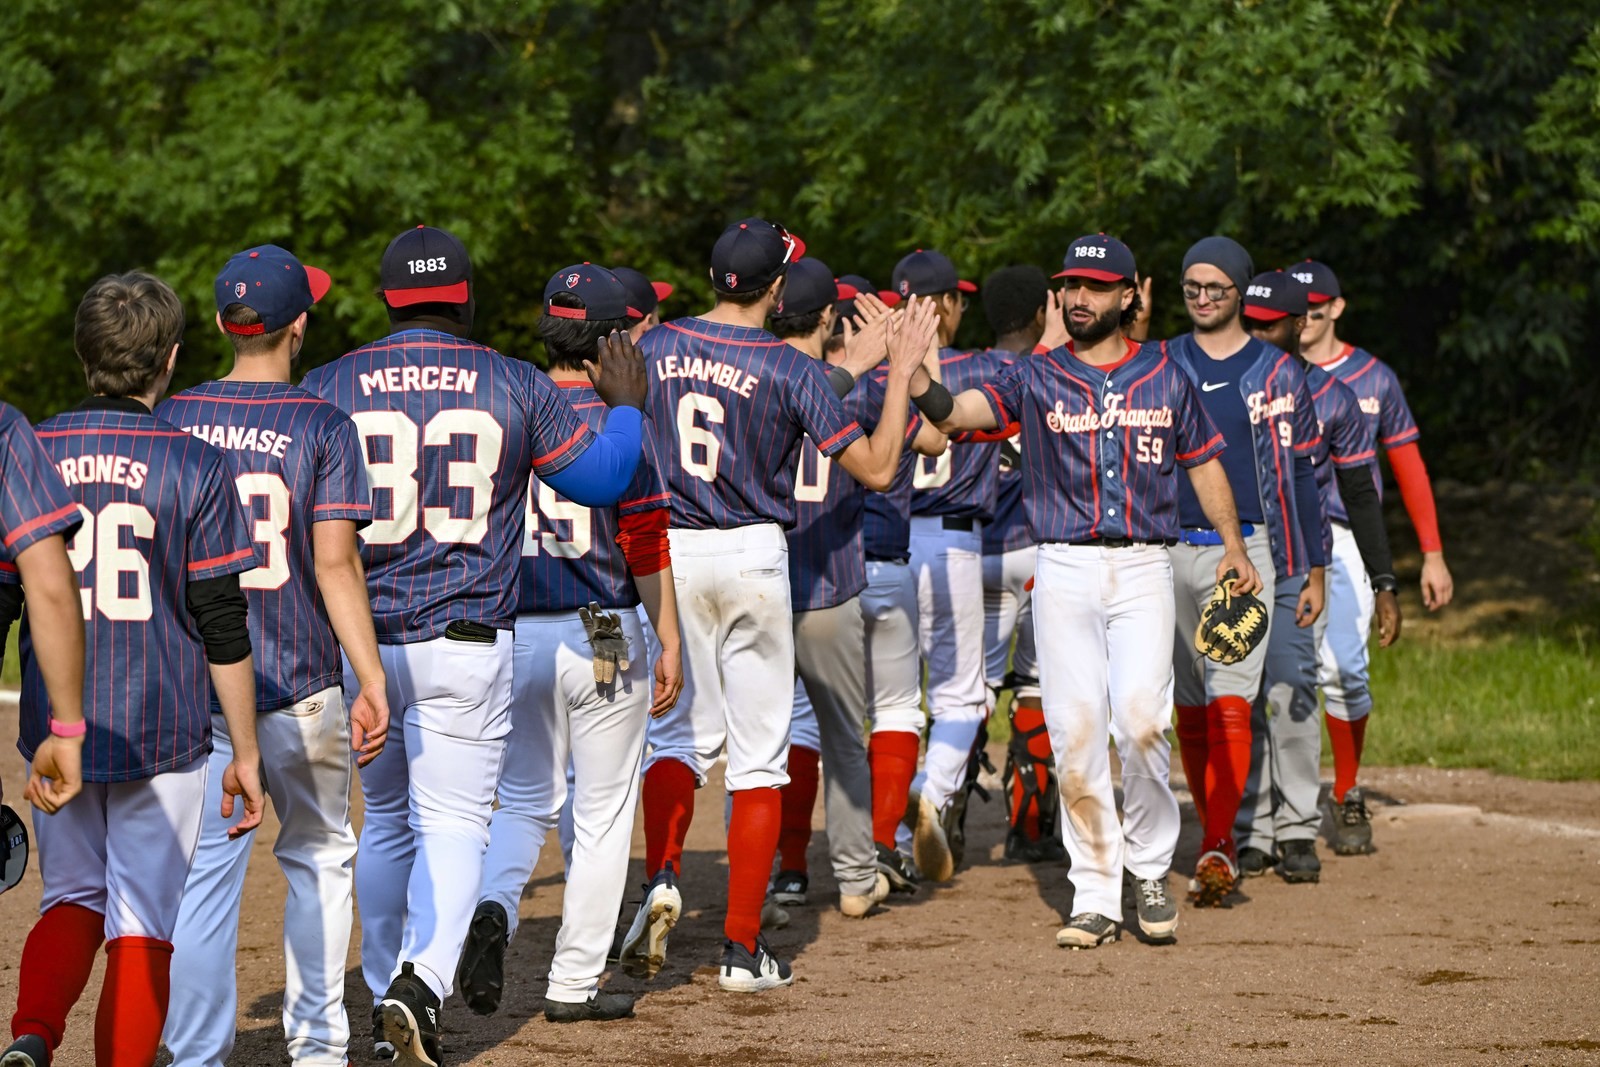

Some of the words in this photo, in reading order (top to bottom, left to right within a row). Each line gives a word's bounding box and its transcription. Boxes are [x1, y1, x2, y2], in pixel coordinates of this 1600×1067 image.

[407, 256, 447, 275] 1883
[1075, 246, 1107, 259] 1883
[1292, 272, 1313, 284] 83
[359, 365, 478, 396] MERCEN
[656, 355, 759, 399] LEJAMBLE
[1046, 400, 1101, 433] Stade
[1101, 392, 1173, 435] Français
[181, 424, 292, 458] HANASE
[677, 392, 725, 482] 6
[1136, 435, 1164, 465] 59
[1278, 421, 1293, 447] 9
[56, 454, 149, 490] RONES
[350, 408, 503, 544] 83
[235, 472, 291, 590] 3
